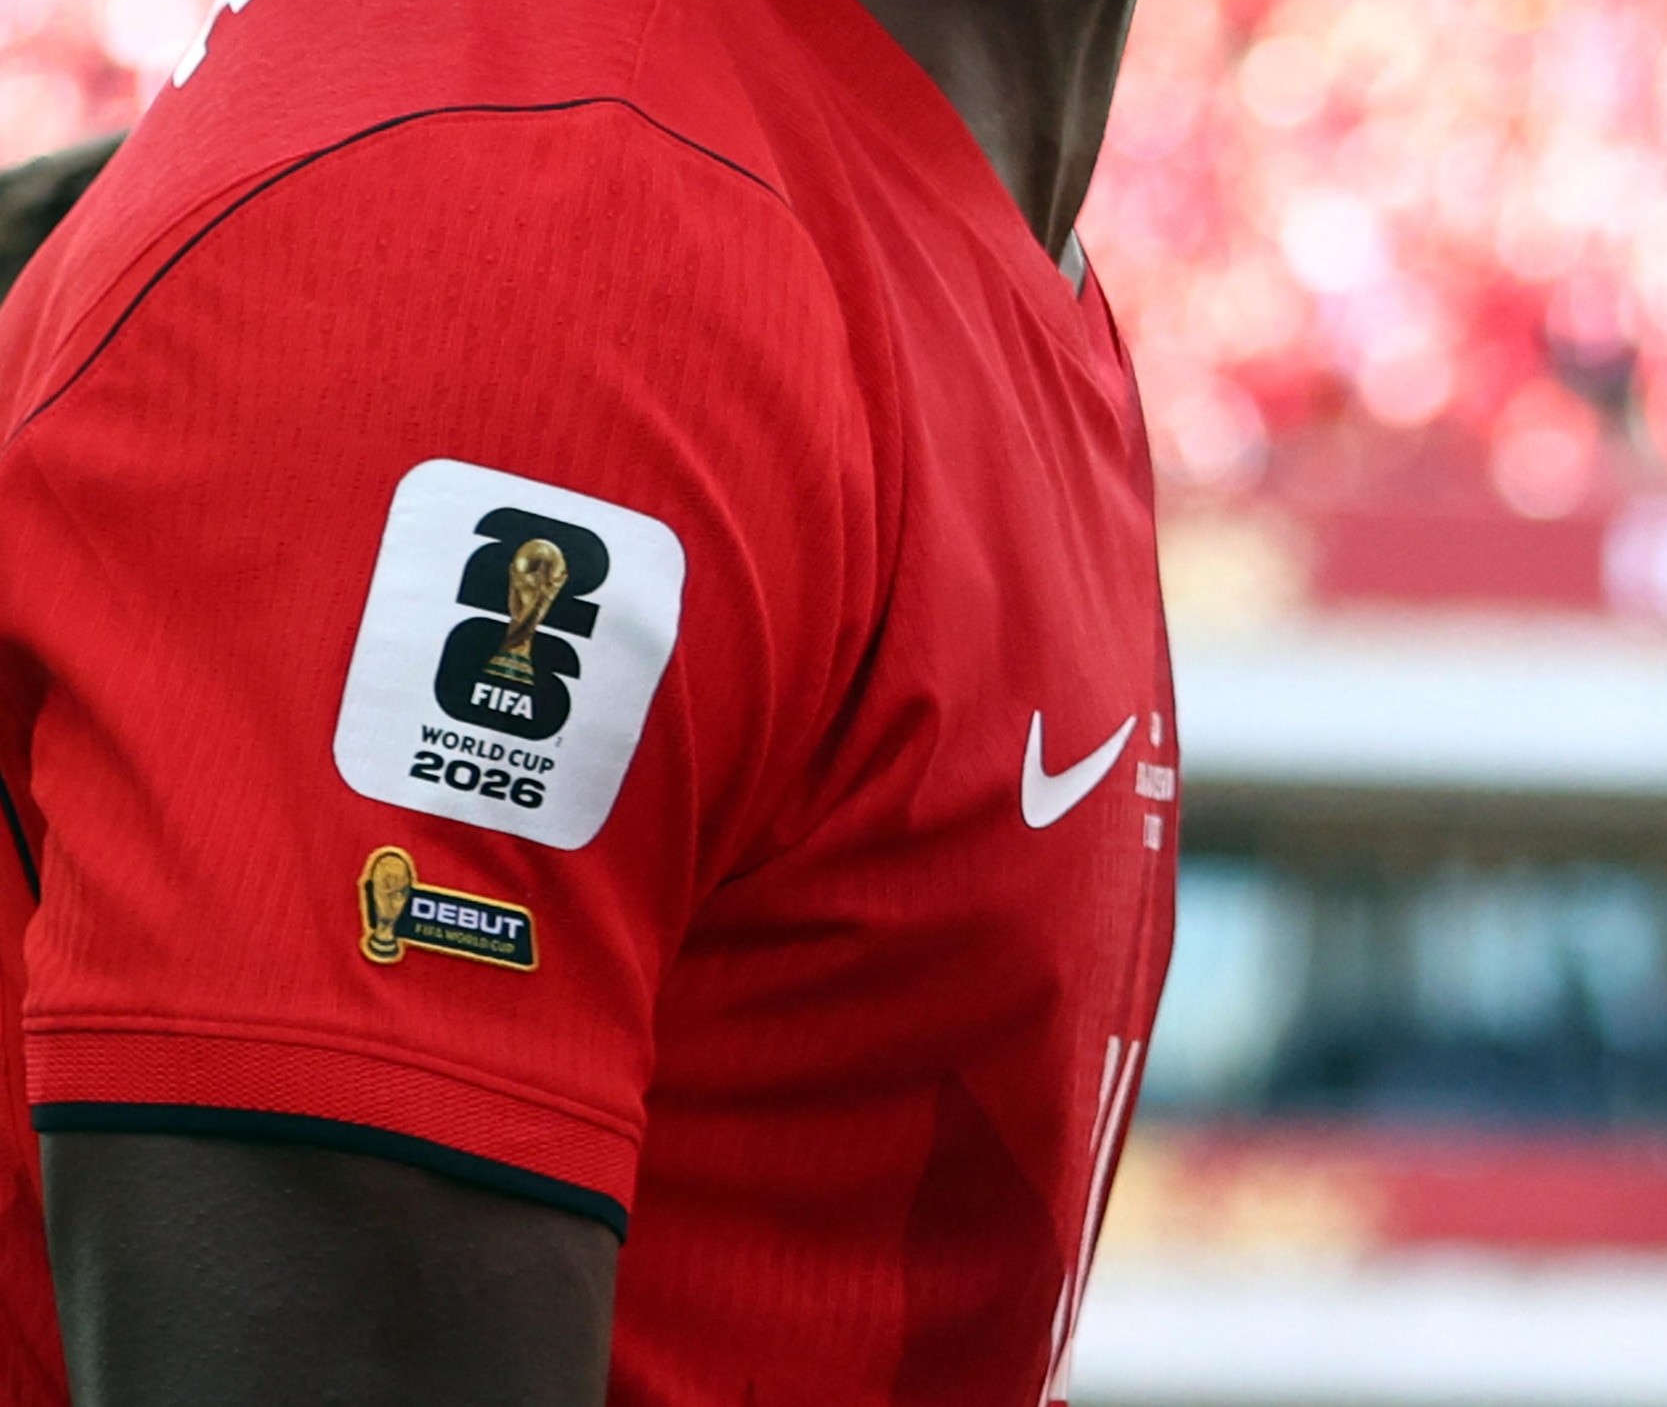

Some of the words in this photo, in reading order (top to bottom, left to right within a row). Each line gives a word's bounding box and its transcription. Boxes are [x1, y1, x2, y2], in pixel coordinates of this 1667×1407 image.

[470, 682, 534, 720] FIFA
[421, 724, 504, 762] WORLD
[508, 749, 555, 775] CUP
[409, 750, 546, 809] 2026
[410, 897, 524, 939] DEBUT
[415, 923, 443, 939] FIFA
[444, 928, 489, 950] WORLD
[490, 938, 515, 954] CUP
